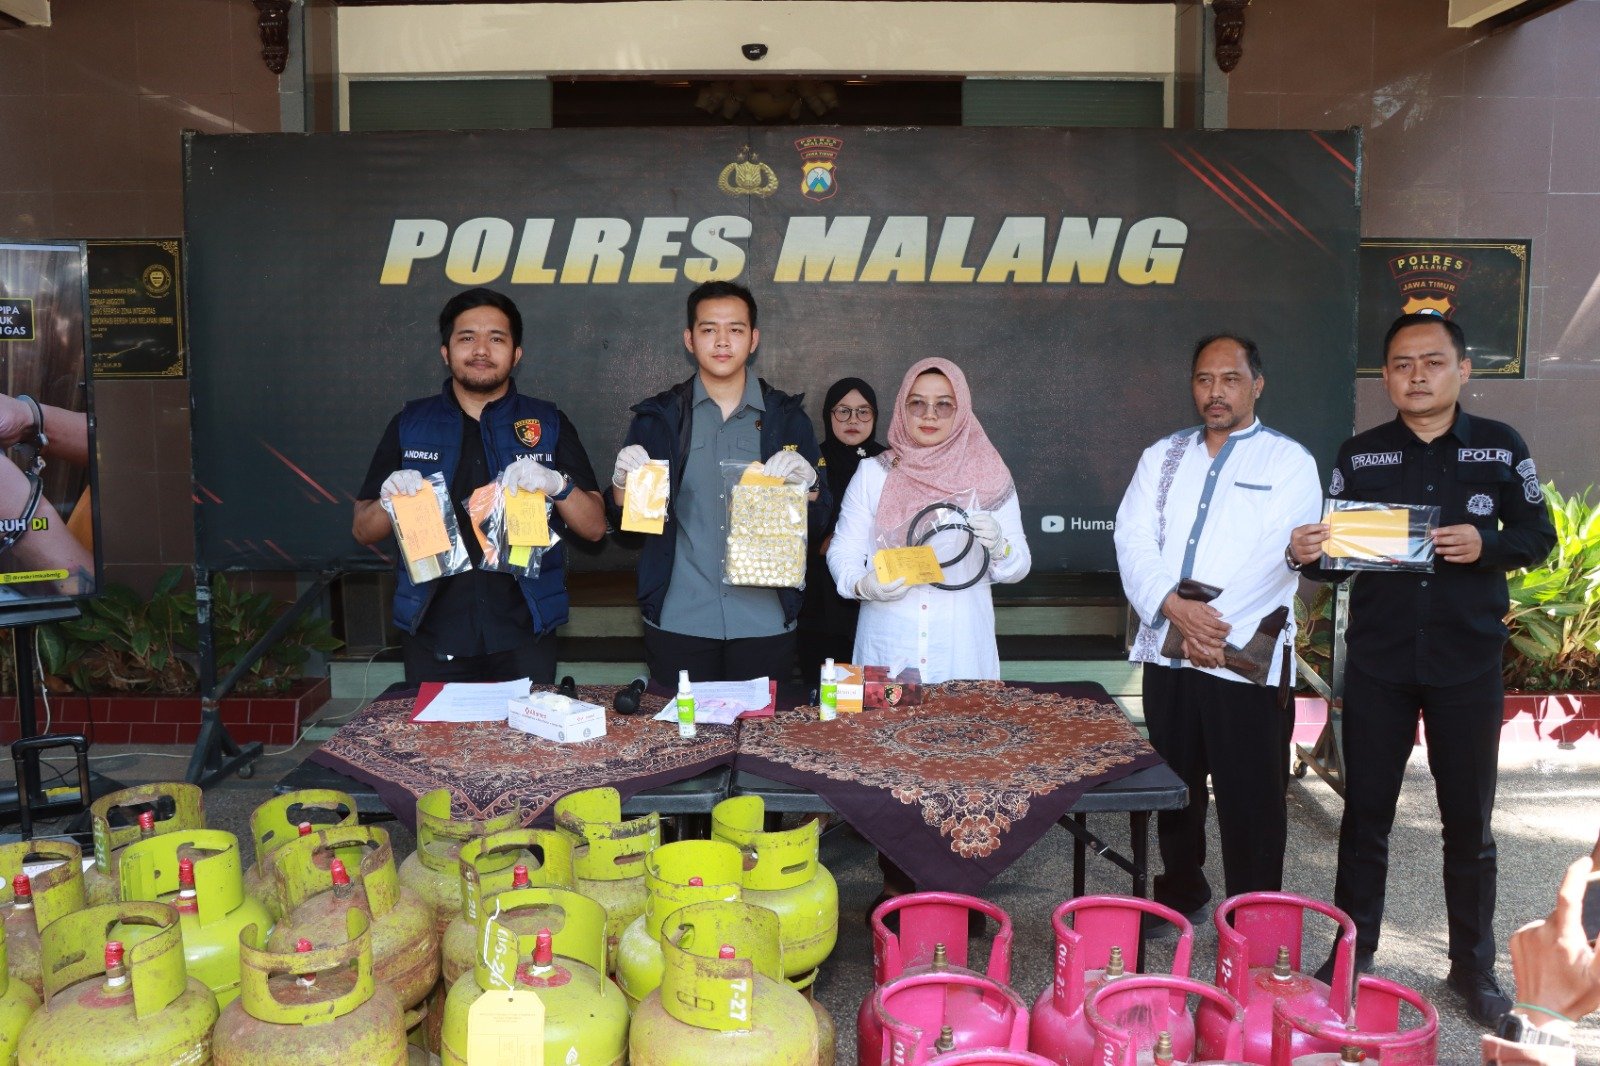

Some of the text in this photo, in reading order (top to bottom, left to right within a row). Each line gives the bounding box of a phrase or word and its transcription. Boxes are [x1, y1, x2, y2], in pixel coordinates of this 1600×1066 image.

[379, 215, 1189, 286] POLRES MALANG
[1397, 255, 1463, 270] POLRES
[1402, 281, 1456, 292] JAWA TIMUR
[4, 326, 26, 335] GAS
[404, 450, 438, 460] ANDREAS
[1354, 454, 1399, 467] PRADANA
[1461, 450, 1510, 463] POLRI
[32, 518, 48, 531] DI
